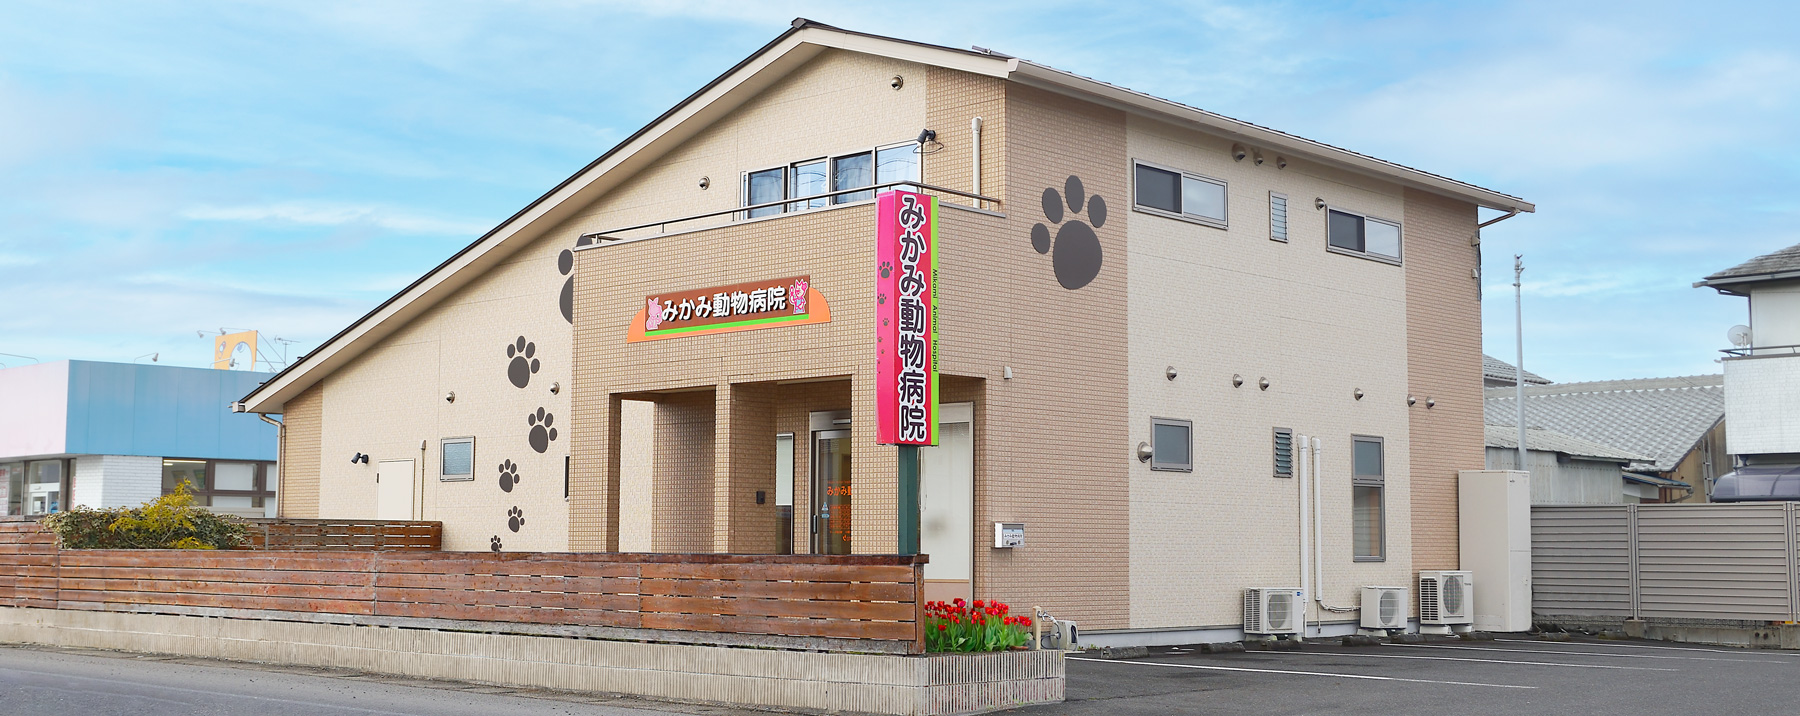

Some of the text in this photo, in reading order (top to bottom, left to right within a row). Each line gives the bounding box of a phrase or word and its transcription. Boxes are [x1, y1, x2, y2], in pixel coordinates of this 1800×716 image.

[662, 285, 787, 322] みかみ動物病院
[900, 196, 926, 440] みかみ動物病院
